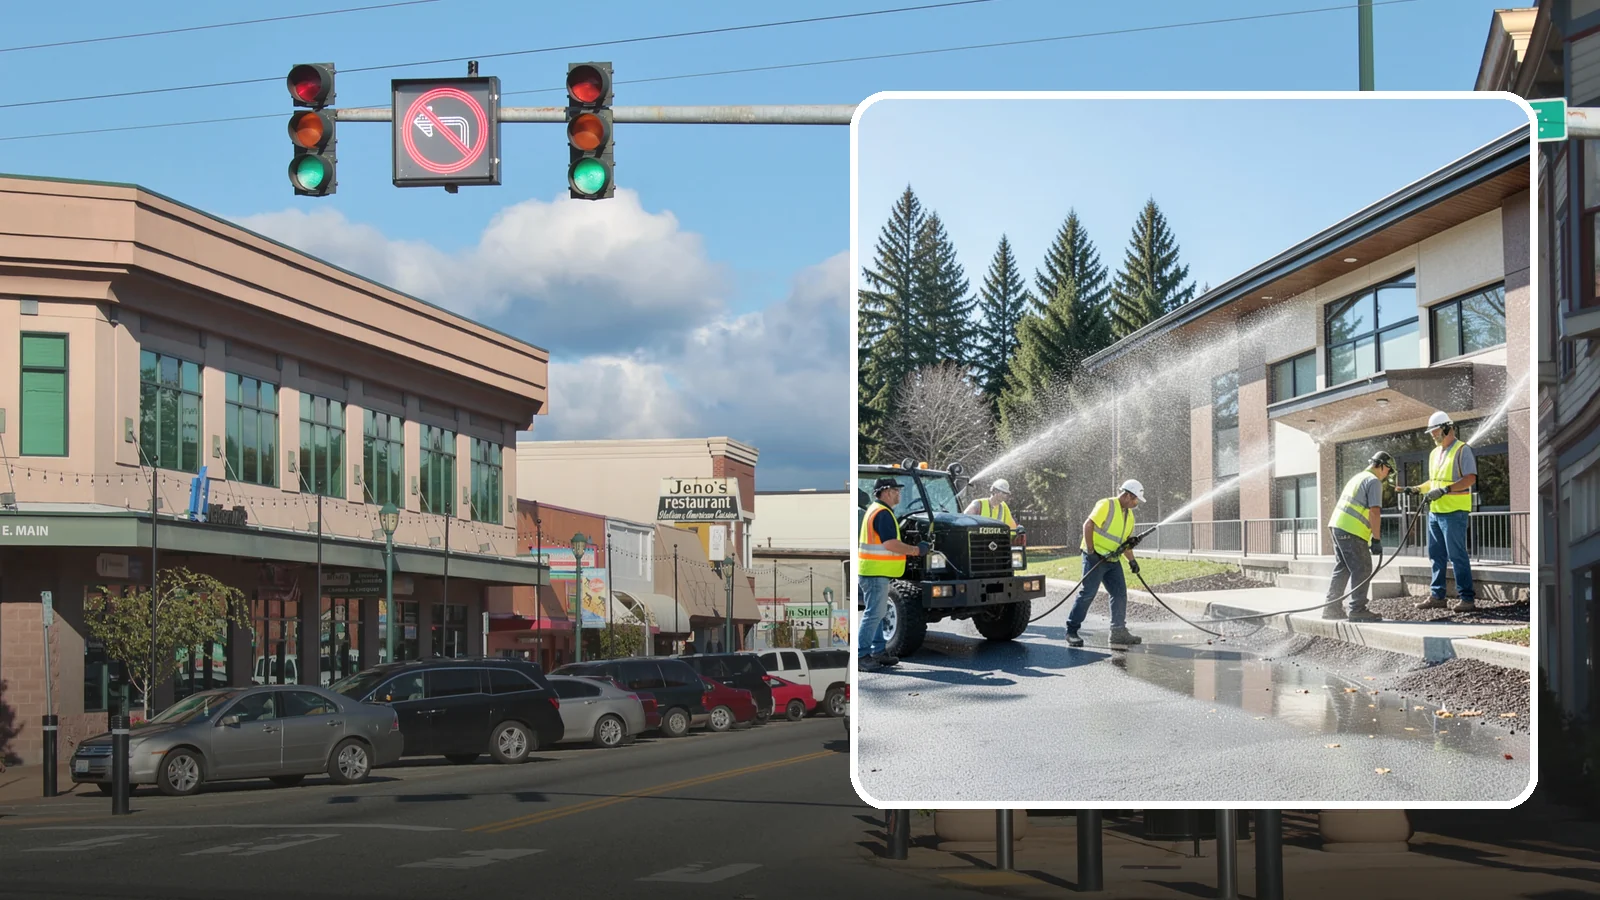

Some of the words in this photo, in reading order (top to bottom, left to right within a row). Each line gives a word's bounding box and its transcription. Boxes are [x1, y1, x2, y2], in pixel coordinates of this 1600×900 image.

[670, 480, 728, 494] Jeno's
[665, 496, 731, 509] restaurant
[659, 510, 681, 520] Italian
[686, 510, 714, 520] American
[715, 509, 737, 520] Cuisine
[2, 525, 13, 536] E.
[15, 525, 49, 536] MAIN
[797, 608, 829, 616] Street
